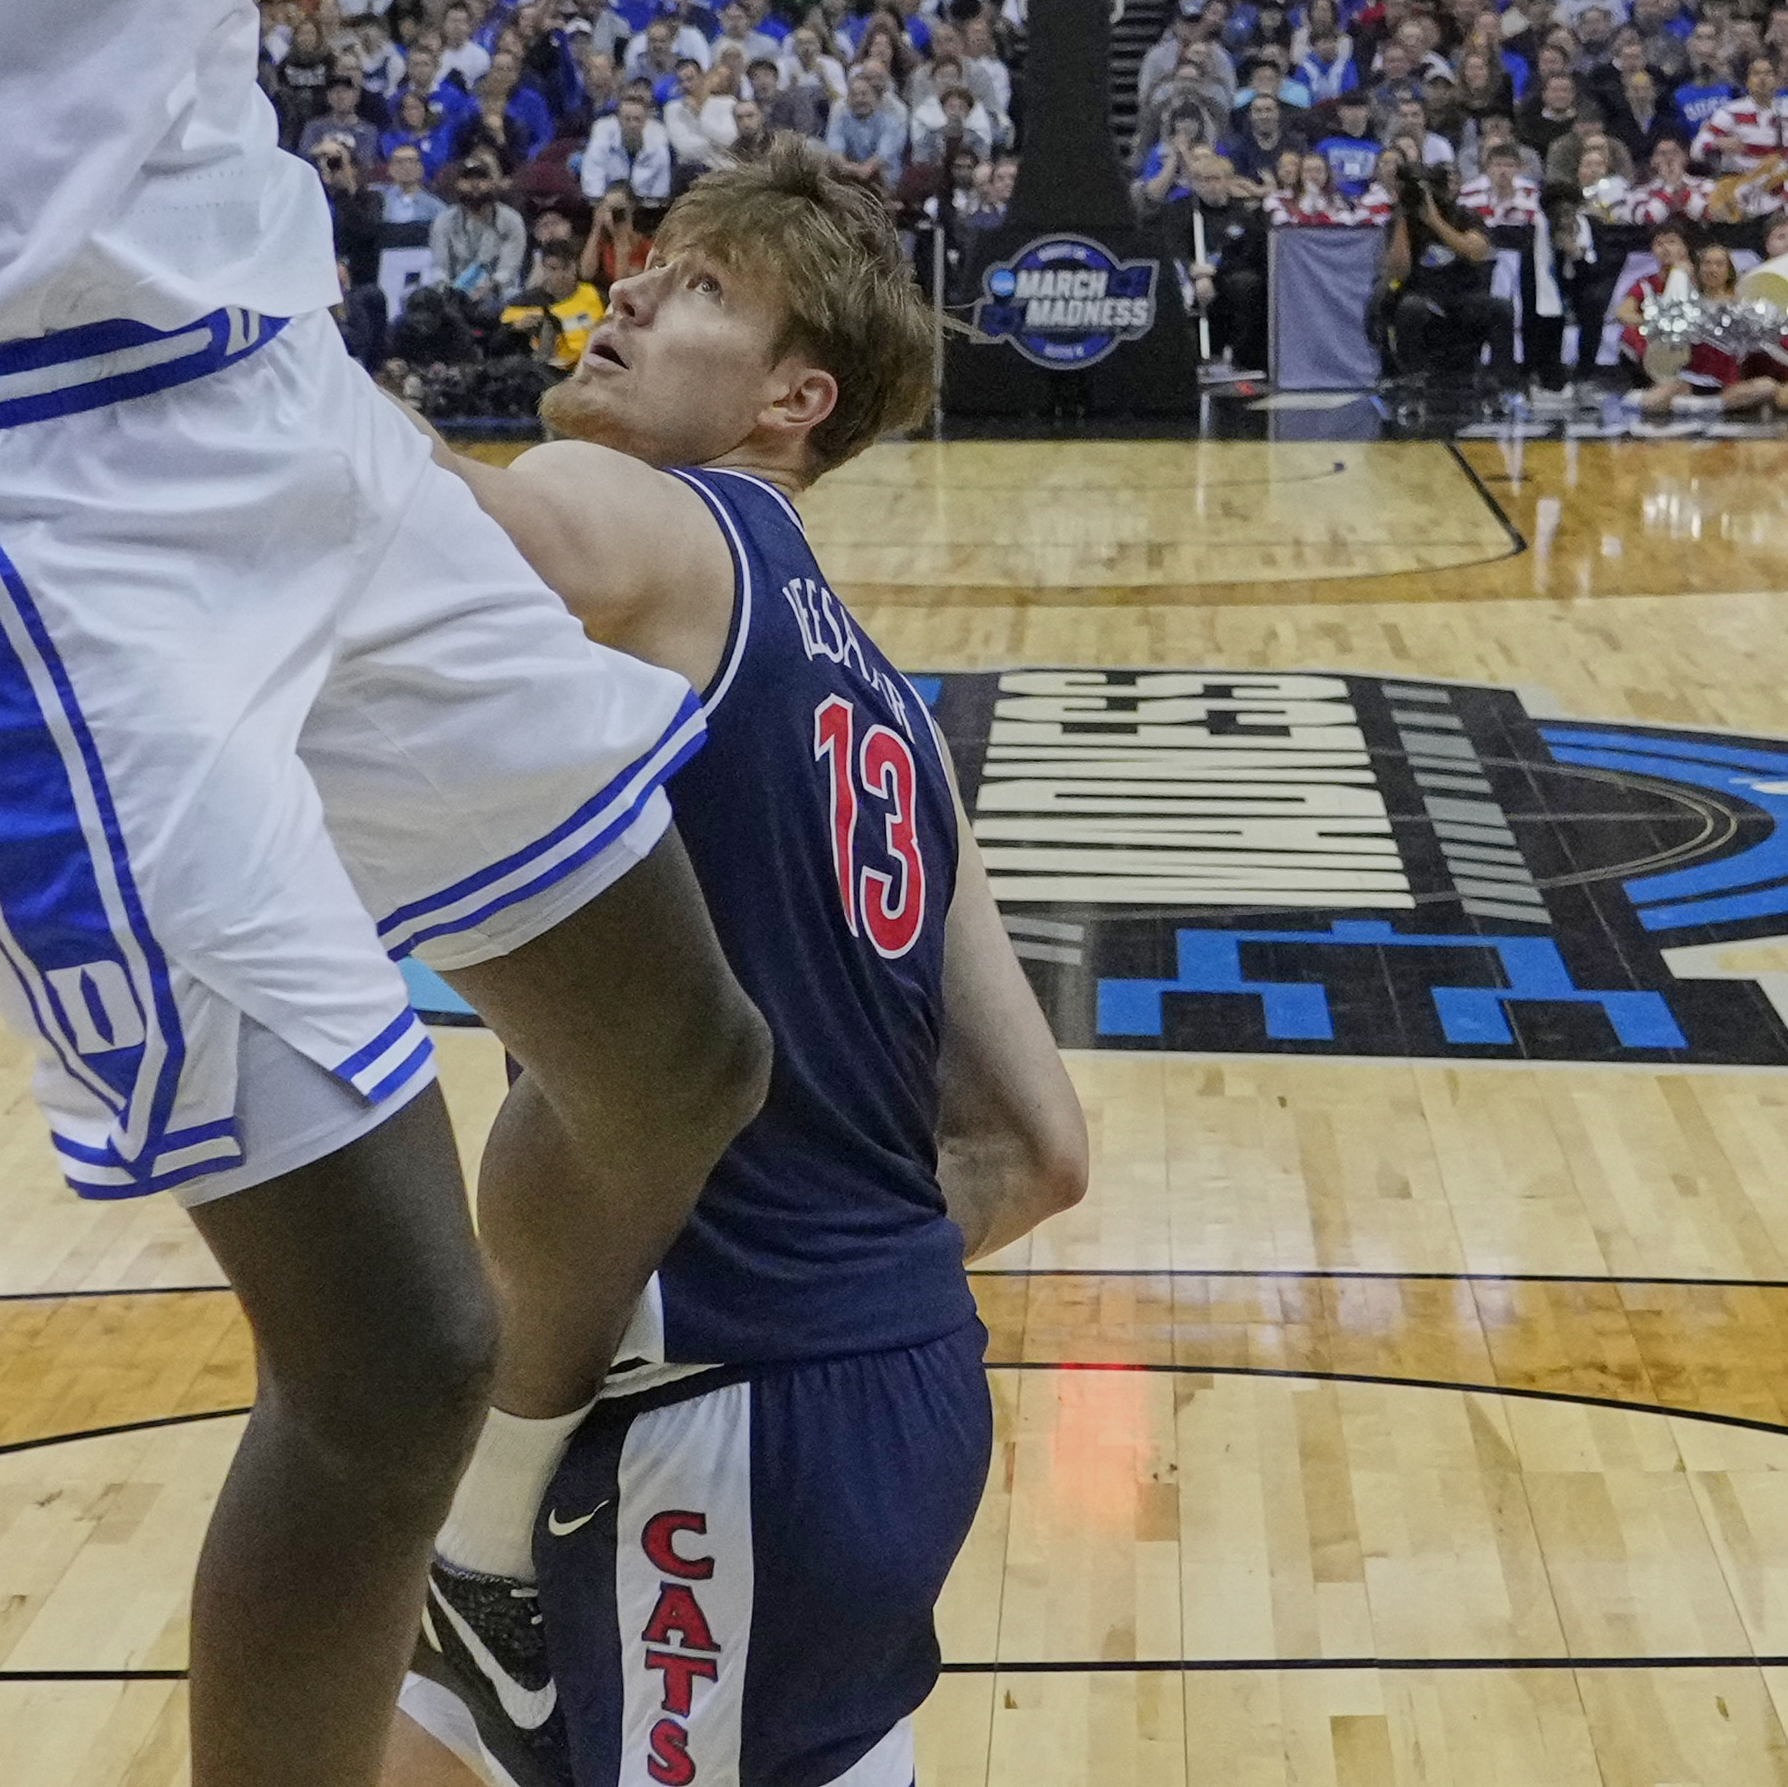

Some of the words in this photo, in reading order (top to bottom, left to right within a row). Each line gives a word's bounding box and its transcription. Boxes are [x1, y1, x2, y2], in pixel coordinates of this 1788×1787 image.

[1015, 268, 1109, 300] MARCH
[1025, 297, 1150, 328] MADNESS
[814, 692, 926, 959] 13
[972, 671, 1415, 910] MADNESS
[45, 960, 147, 1055] D
[641, 1510, 721, 1786] CATS
